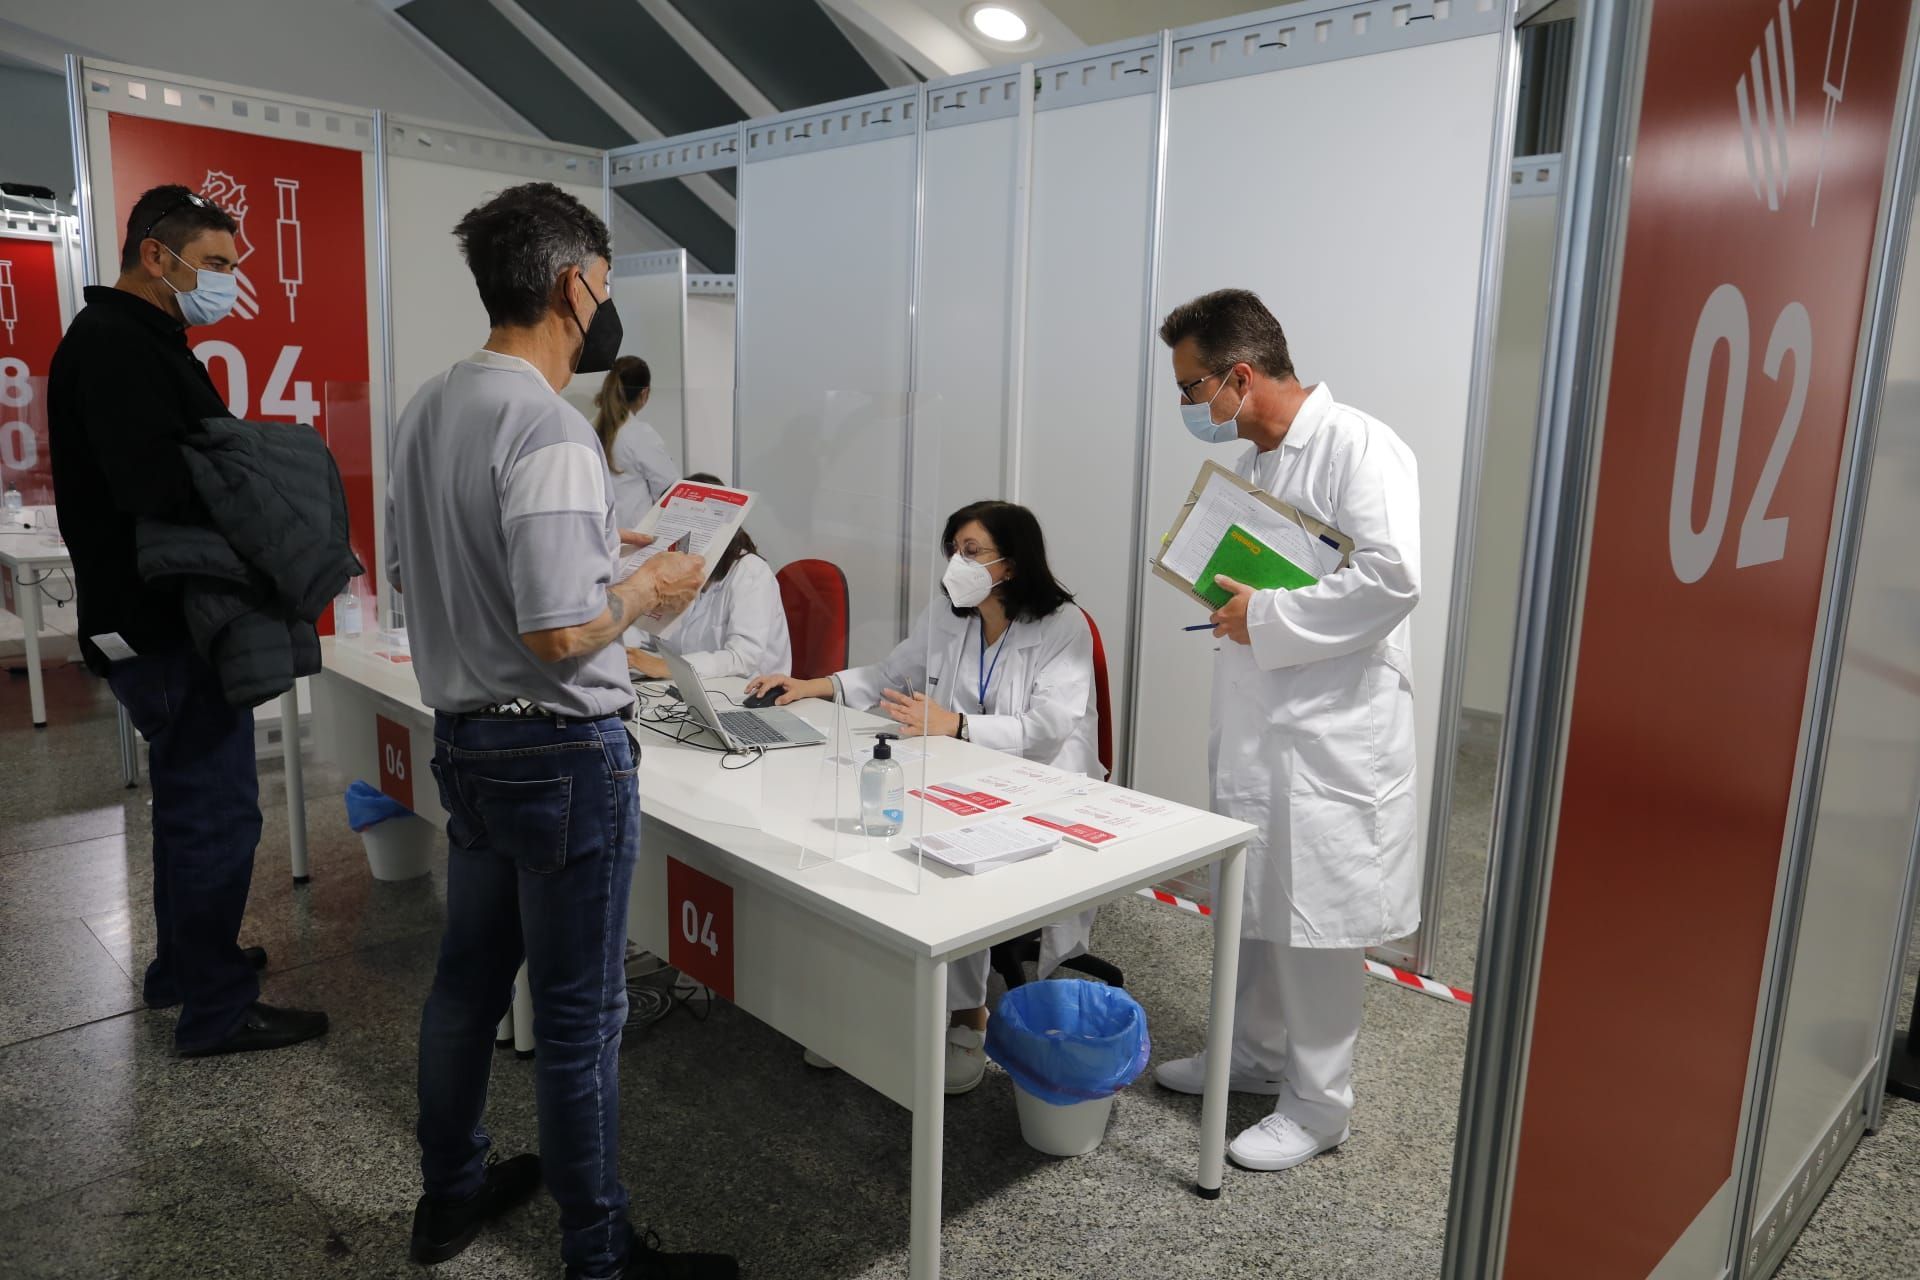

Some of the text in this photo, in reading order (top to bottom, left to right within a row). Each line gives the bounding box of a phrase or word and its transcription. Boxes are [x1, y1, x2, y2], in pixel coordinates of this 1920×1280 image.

[192, 340, 320, 427] 04
[1669, 283, 1812, 584] 02
[385, 743, 405, 780] 06
[682, 899, 719, 956] 04
